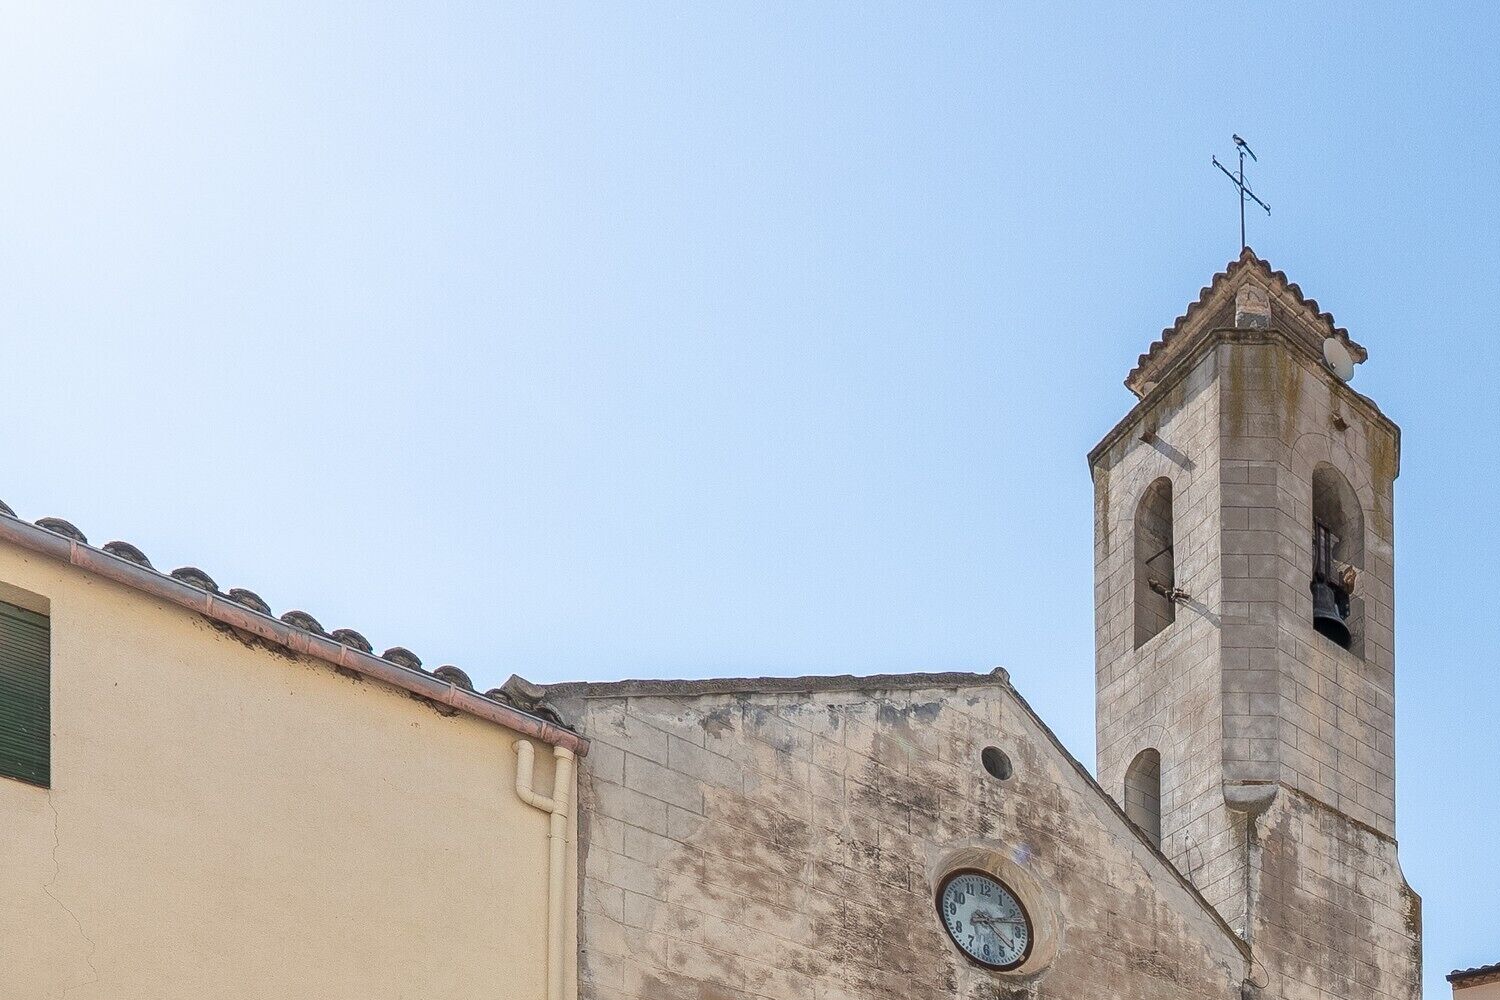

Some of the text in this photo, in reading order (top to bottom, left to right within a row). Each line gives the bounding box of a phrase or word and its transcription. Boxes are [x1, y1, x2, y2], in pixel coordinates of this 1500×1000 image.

[966, 882, 975, 896] 11
[980, 883, 991, 898] 12
[953, 889, 966, 905] 10
[998, 894, 1004, 907] 1
[949, 902, 957, 916] 9
[955, 920, 963, 933] 8
[1014, 926, 1022, 939] 3
[967, 934, 975, 947] 7
[982, 943, 990, 957] 6
[998, 944, 1006, 958] 5
